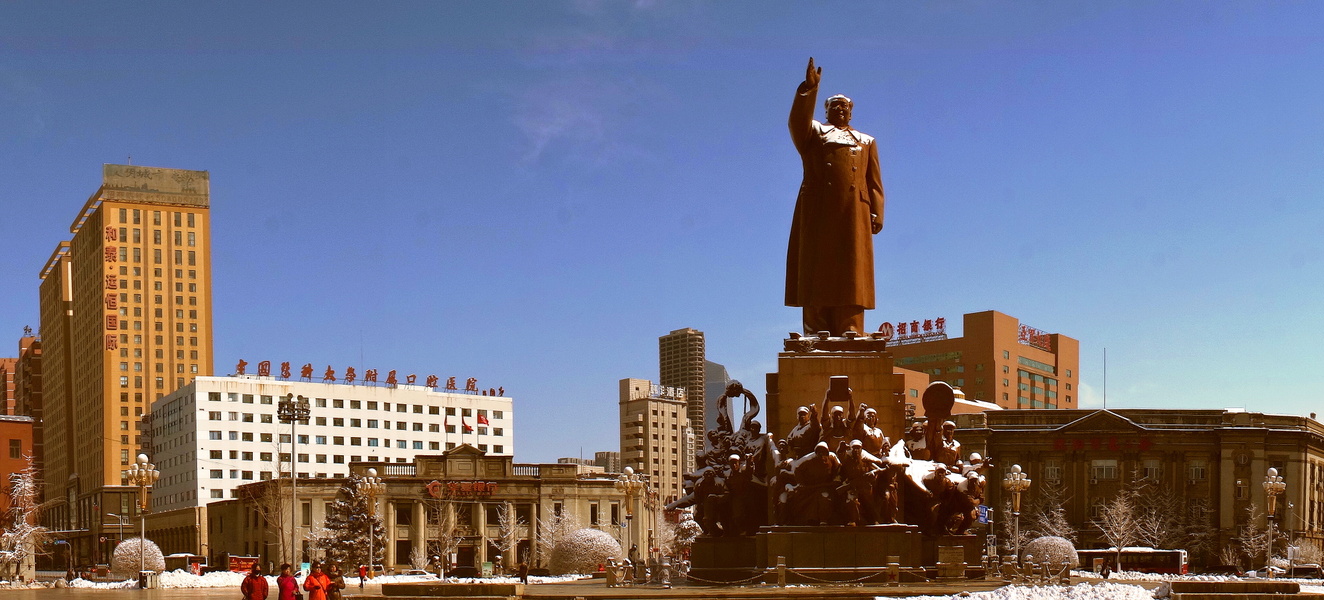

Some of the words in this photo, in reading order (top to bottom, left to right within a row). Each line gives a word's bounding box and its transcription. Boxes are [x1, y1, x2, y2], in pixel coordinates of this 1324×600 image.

[897, 317, 944, 335] 招商银行
[446, 481, 498, 492] 华夏银行
